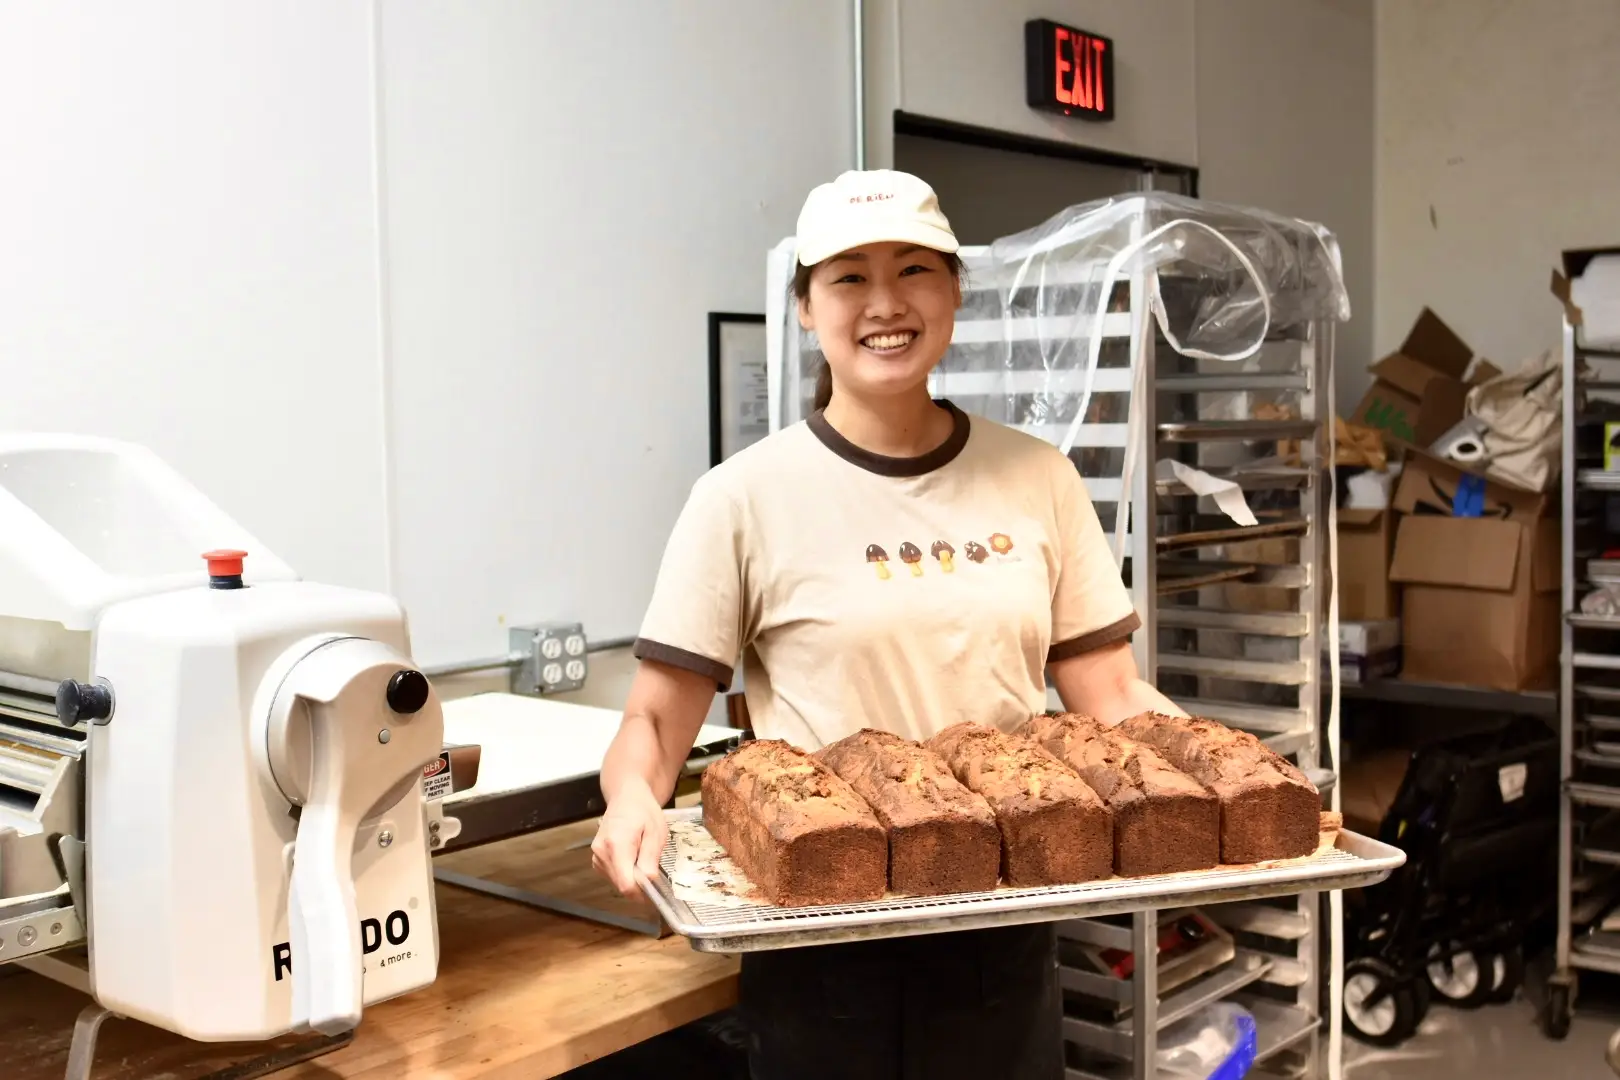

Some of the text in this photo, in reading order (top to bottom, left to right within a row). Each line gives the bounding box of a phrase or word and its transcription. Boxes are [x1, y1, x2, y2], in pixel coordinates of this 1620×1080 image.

[1055, 27, 1105, 112] EXIT
[434, 776, 450, 784] CLEAR
[430, 782, 450, 791] MOVING
[428, 789, 444, 797] PARTS
[272, 909, 410, 982] RDO
